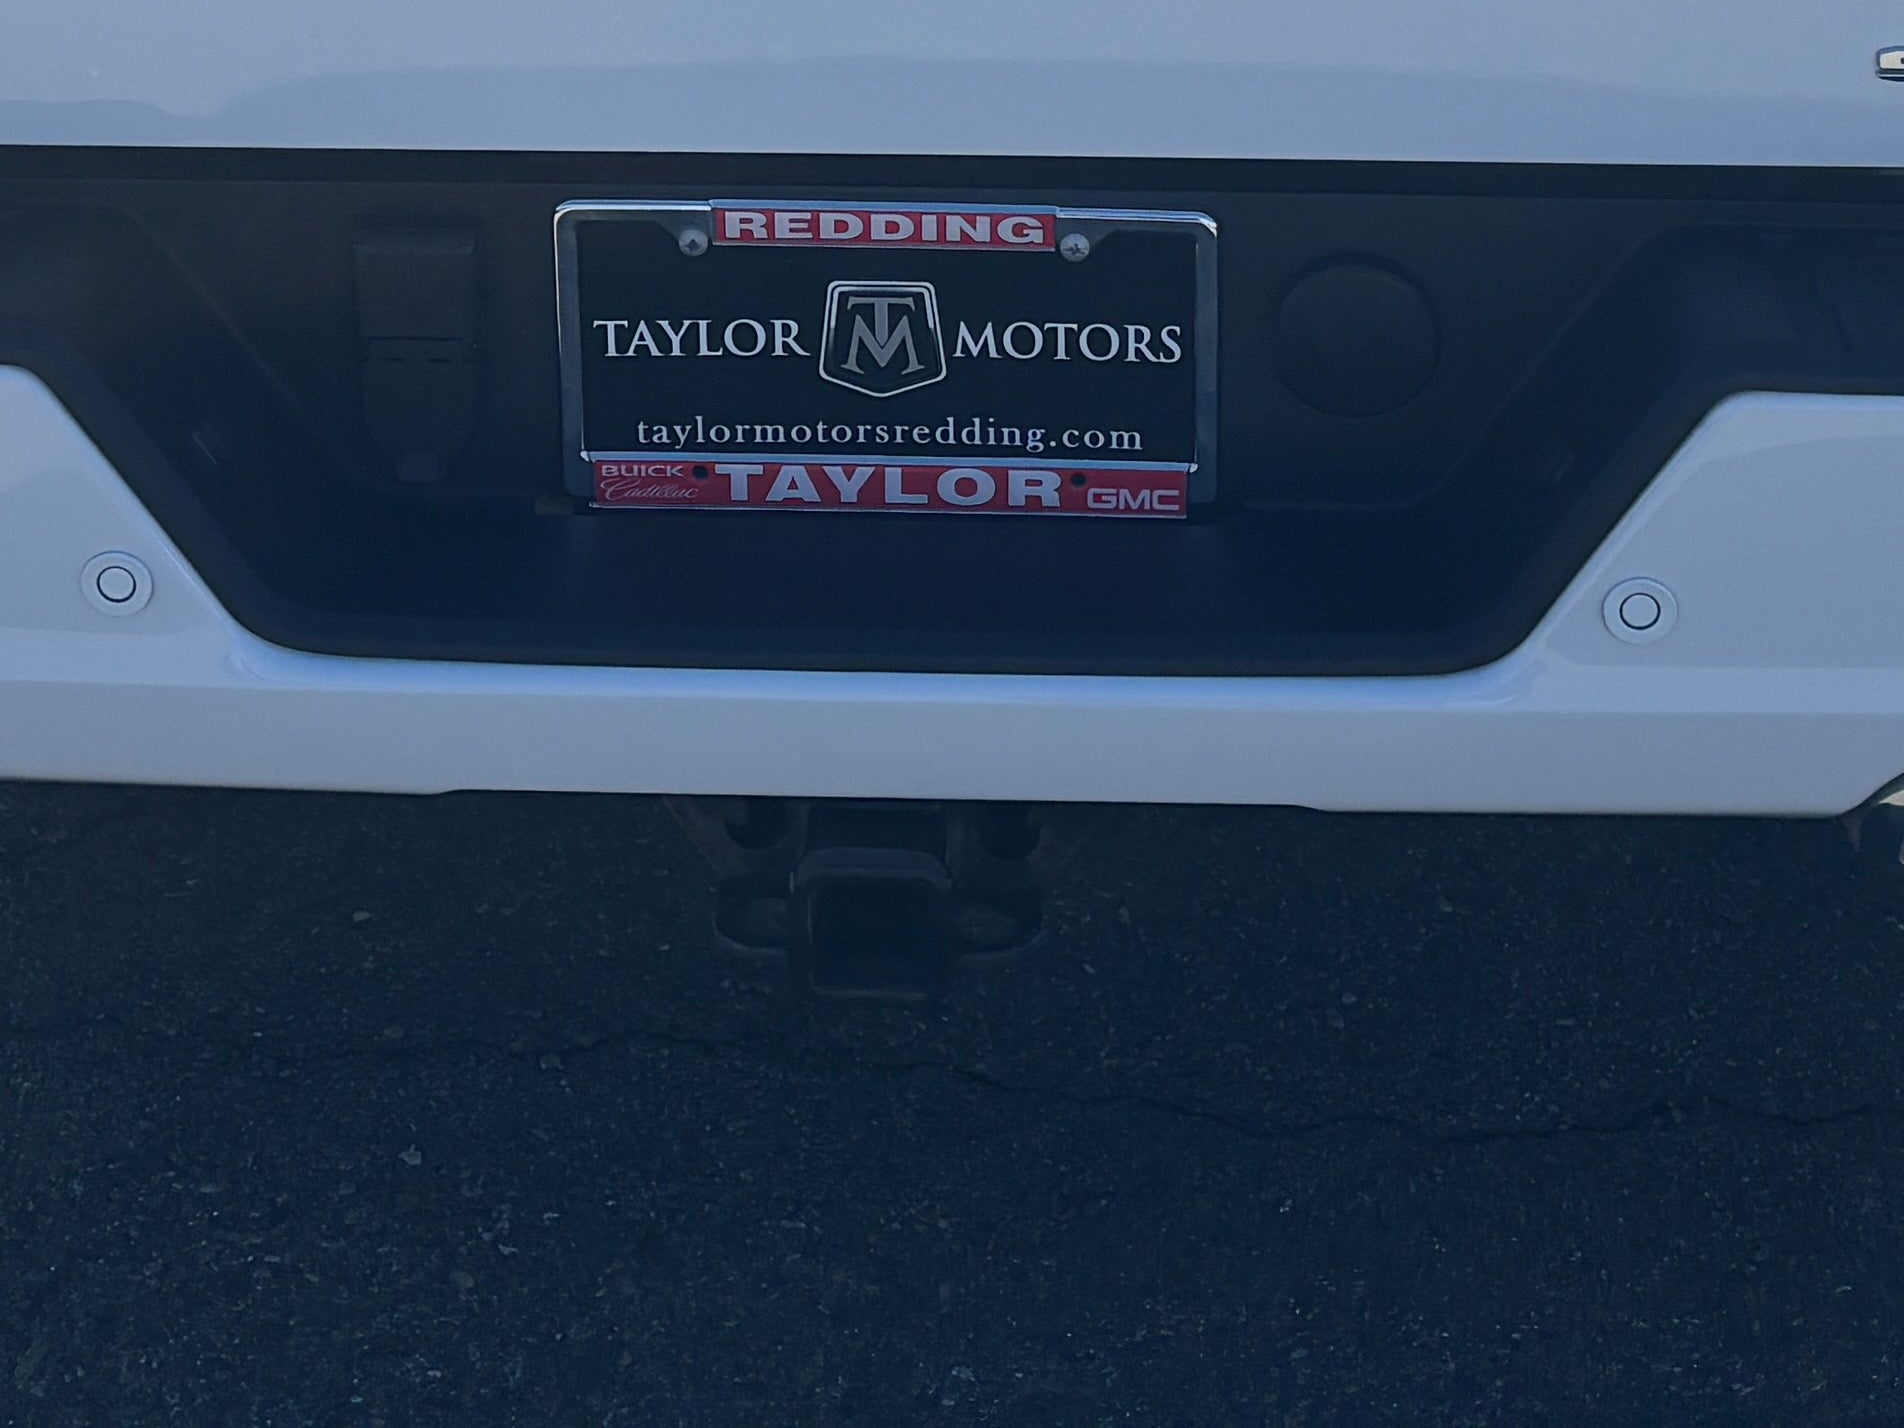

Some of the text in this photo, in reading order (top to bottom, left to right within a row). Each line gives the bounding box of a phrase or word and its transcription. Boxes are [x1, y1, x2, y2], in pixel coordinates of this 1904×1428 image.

[724, 210, 1047, 245] REDDING
[593, 318, 811, 358] TAYLOR
[951, 320, 1183, 364] MOTORS
[636, 416, 1143, 452] taylormotorsredding.com
[601, 465, 685, 477] BUICK
[714, 463, 1062, 508] TAYLOR
[599, 477, 699, 502] Cadillac
[1086, 487, 1180, 511] GMC
